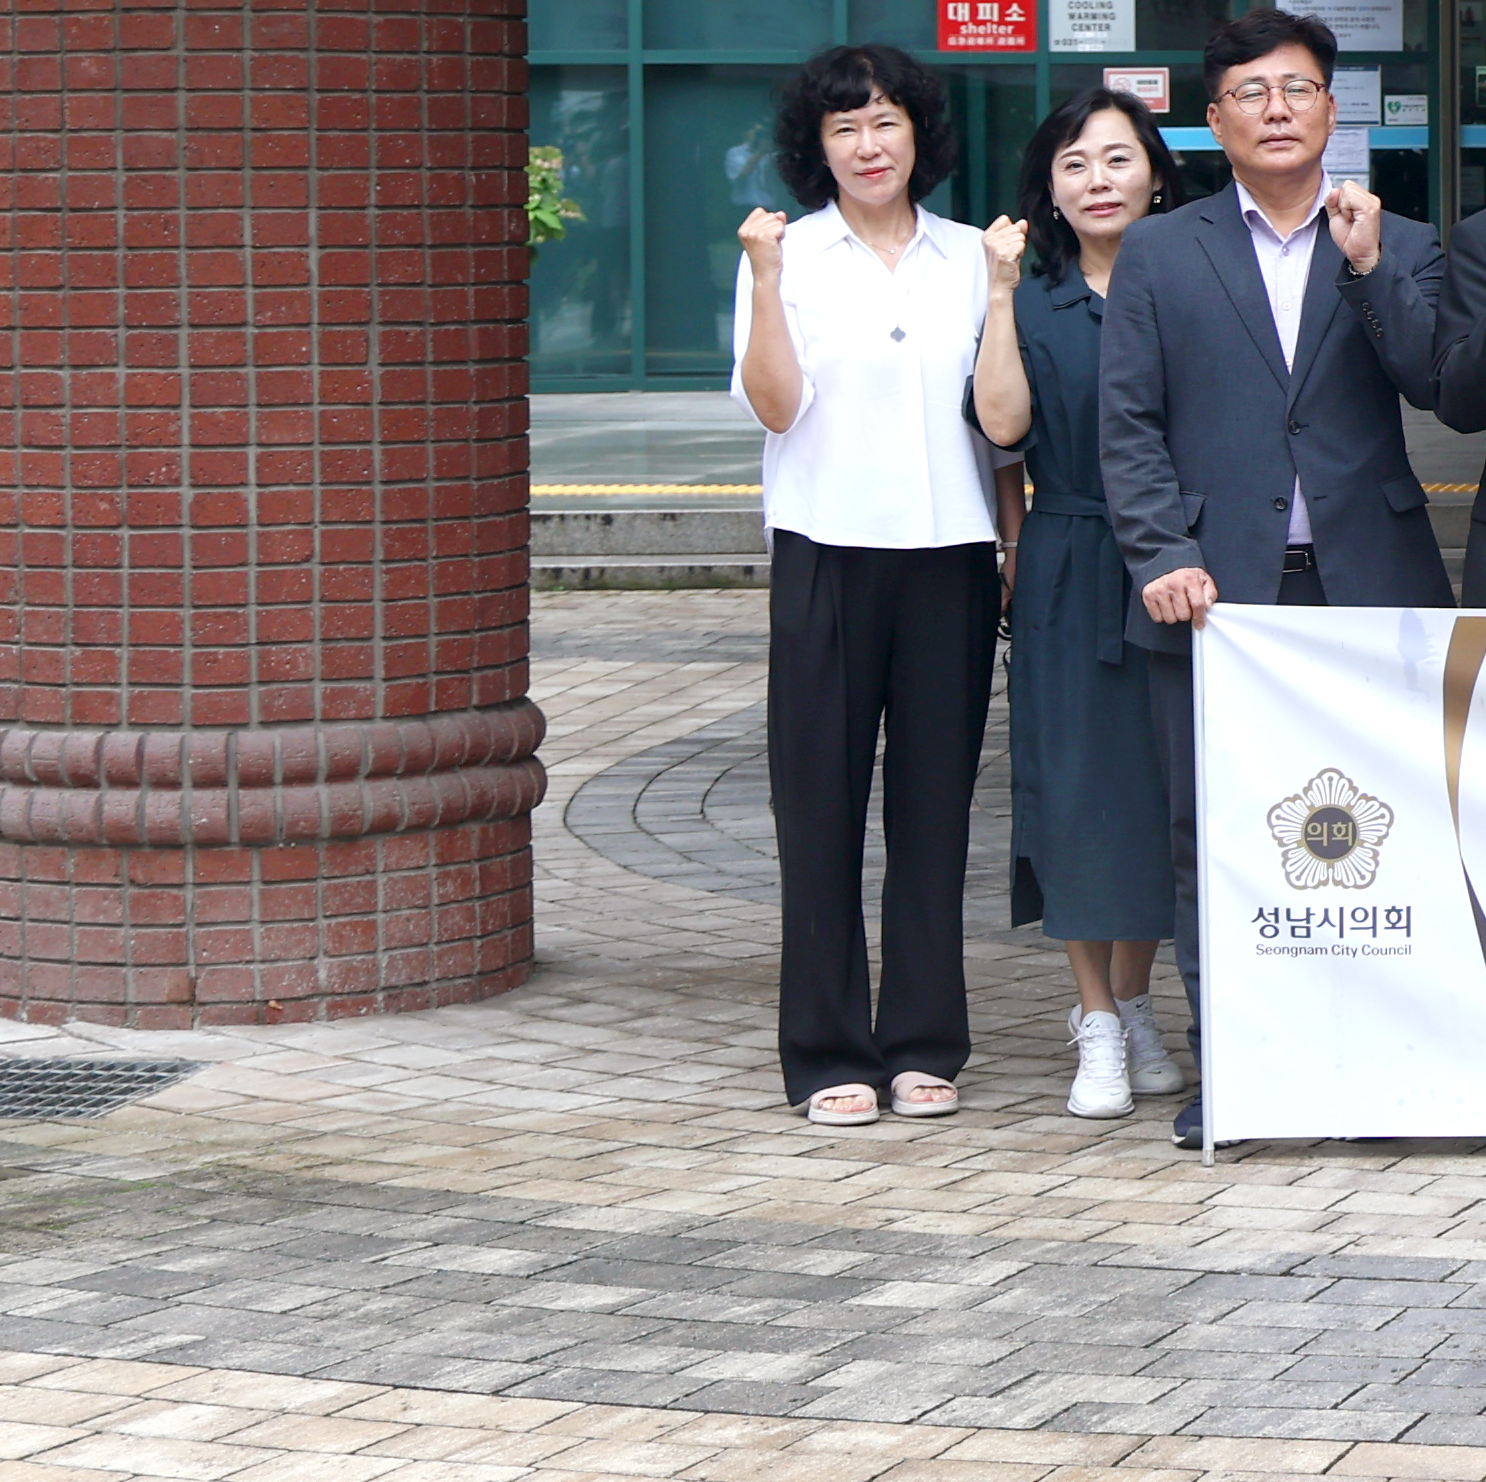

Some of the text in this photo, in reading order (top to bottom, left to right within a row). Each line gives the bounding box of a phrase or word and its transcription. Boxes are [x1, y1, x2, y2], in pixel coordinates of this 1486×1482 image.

[946, 2, 1026, 22] 대피소
[1067, 0, 1114, 10] COOLING
[1068, 11, 1117, 21] WARMING
[959, 21, 1015, 34] shelter
[1071, 22, 1111, 32] CENTER
[1306, 821, 1353, 847] 의회
[1252, 906, 1411, 938] 성남시의회
[1255, 943, 1412, 958] Seongnam City Council
